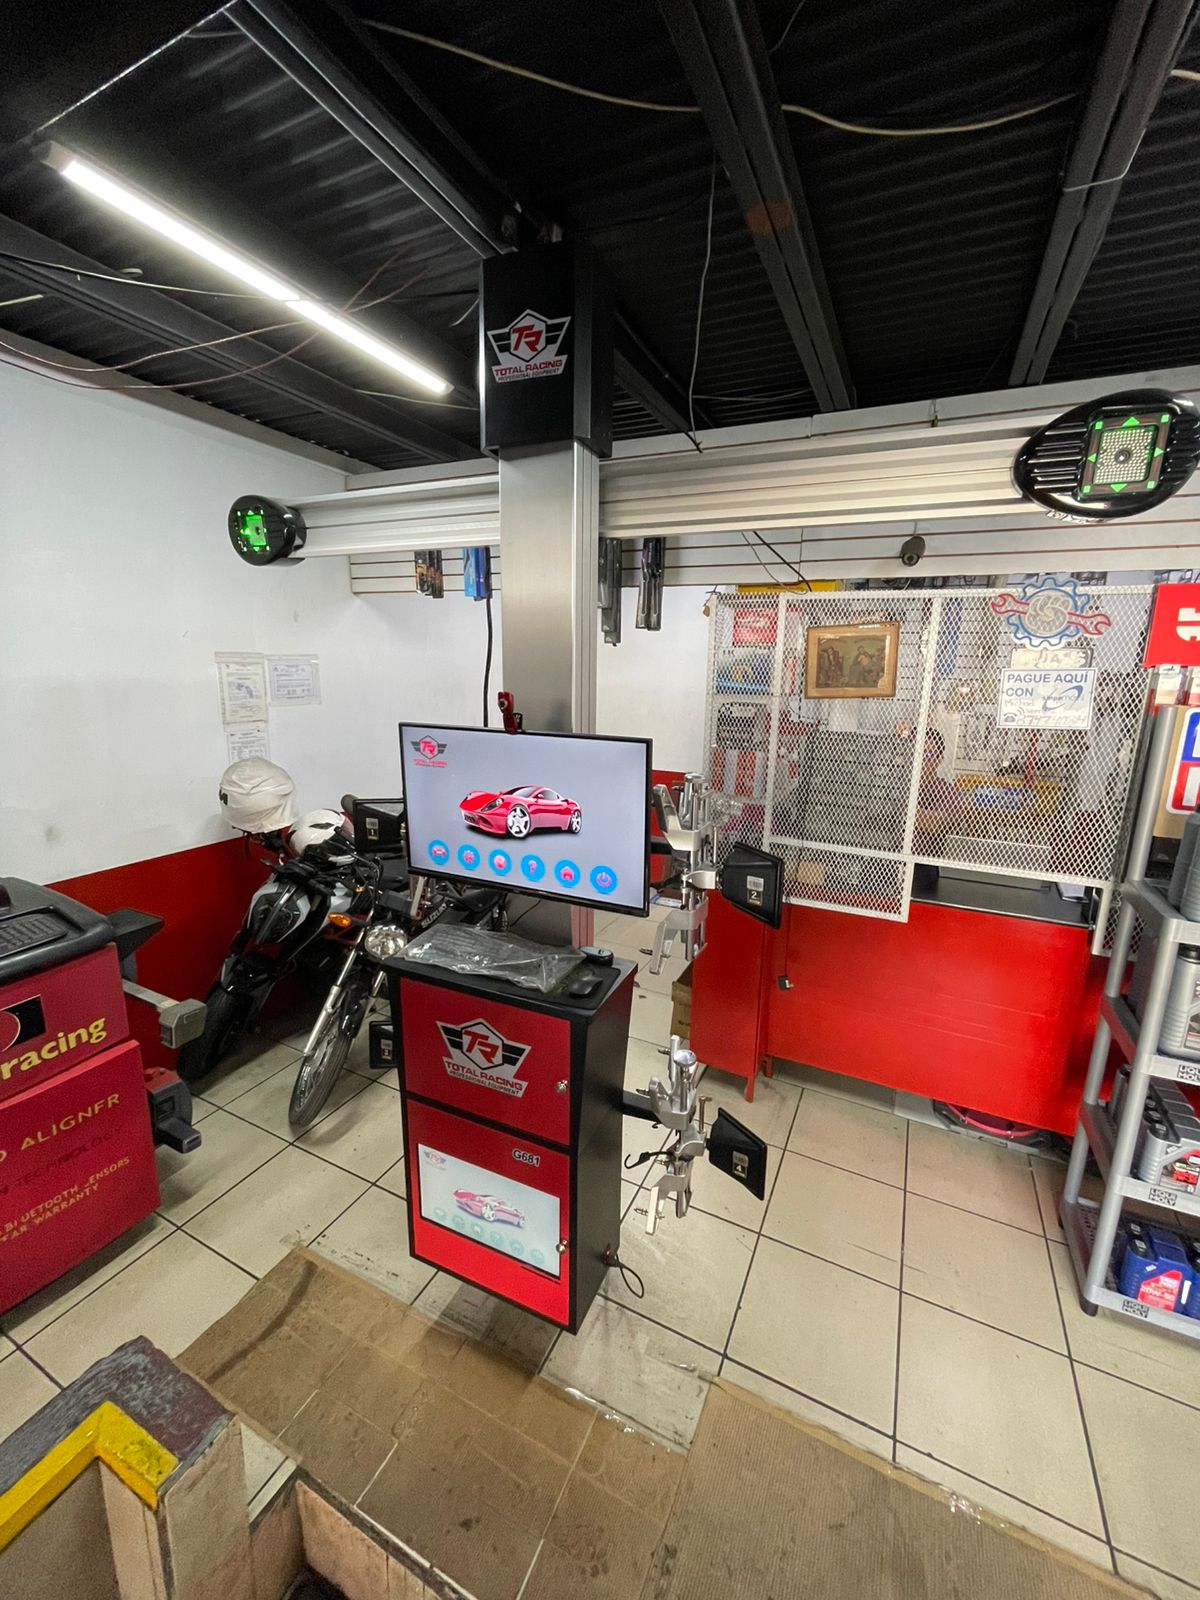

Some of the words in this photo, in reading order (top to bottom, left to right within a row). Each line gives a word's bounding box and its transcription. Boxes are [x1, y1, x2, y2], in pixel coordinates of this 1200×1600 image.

[512, 324, 543, 352] TR
[495, 367, 524, 376] TOTAL
[525, 360, 562, 372] RACING
[1006, 688, 1034, 697] CON
[1007, 674, 1051, 683] PAGUE
[0, 1017, 107, 1080] racing
[463, 1029, 499, 1065] TR
[445, 1061, 480, 1077] TOTAL
[480, 1072, 523, 1091] RACING
[487, 1081, 520, 1096] EQUIPMENT
[84, 1156, 130, 1188] ENSORS
[513, 1149, 540, 1167] G681
[33, 1183, 99, 1225] WARRANTY
